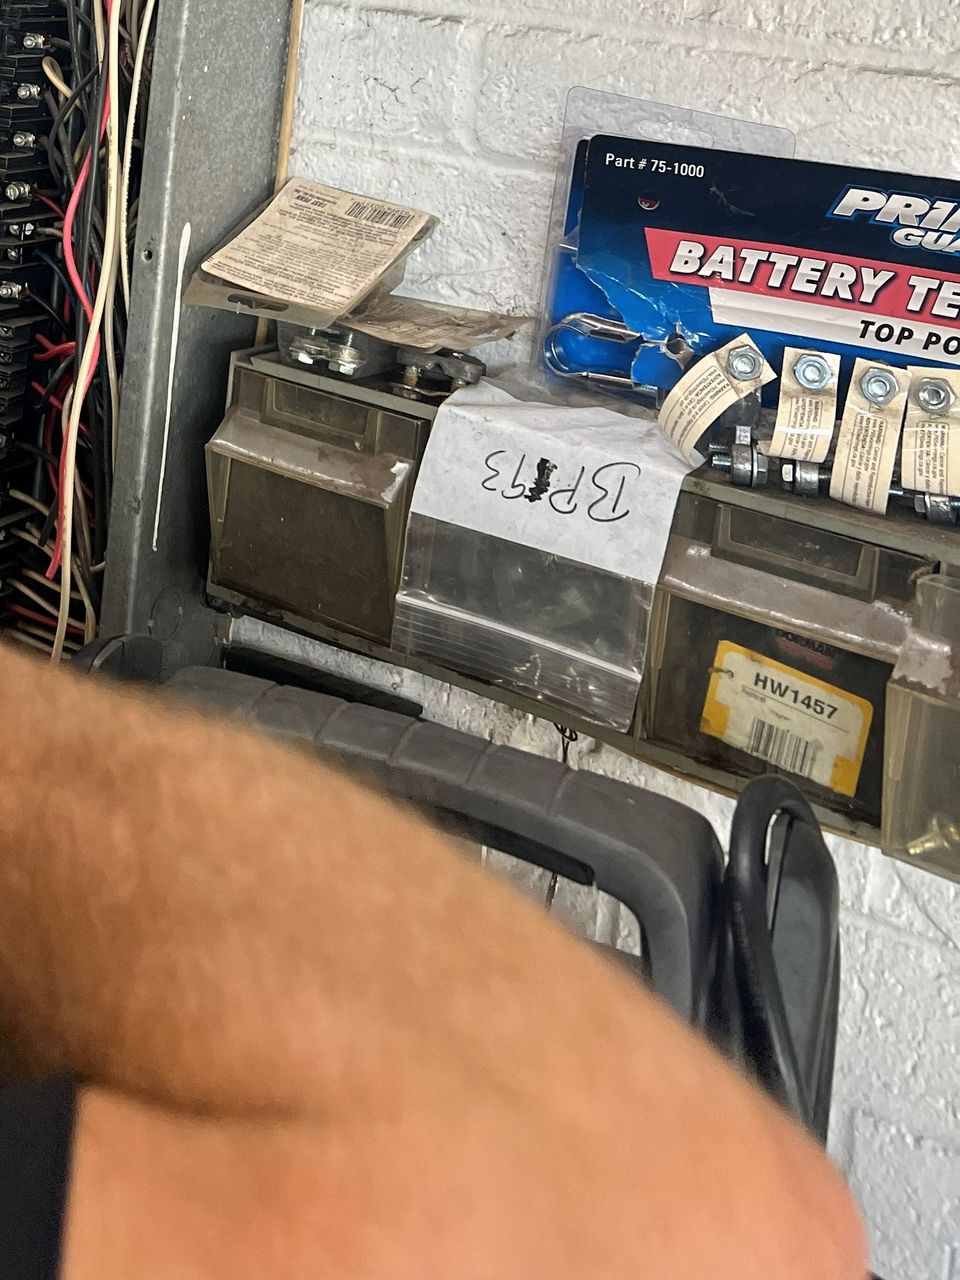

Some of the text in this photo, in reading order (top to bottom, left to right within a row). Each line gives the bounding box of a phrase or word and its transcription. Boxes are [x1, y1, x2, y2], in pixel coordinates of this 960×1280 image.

[605, 153, 705, 178] Part # 75-1000
[670, 240, 960, 318] BATTERY TE
[859, 320, 960, 355] TOP PO
[753, 672, 838, 720] HW1457
